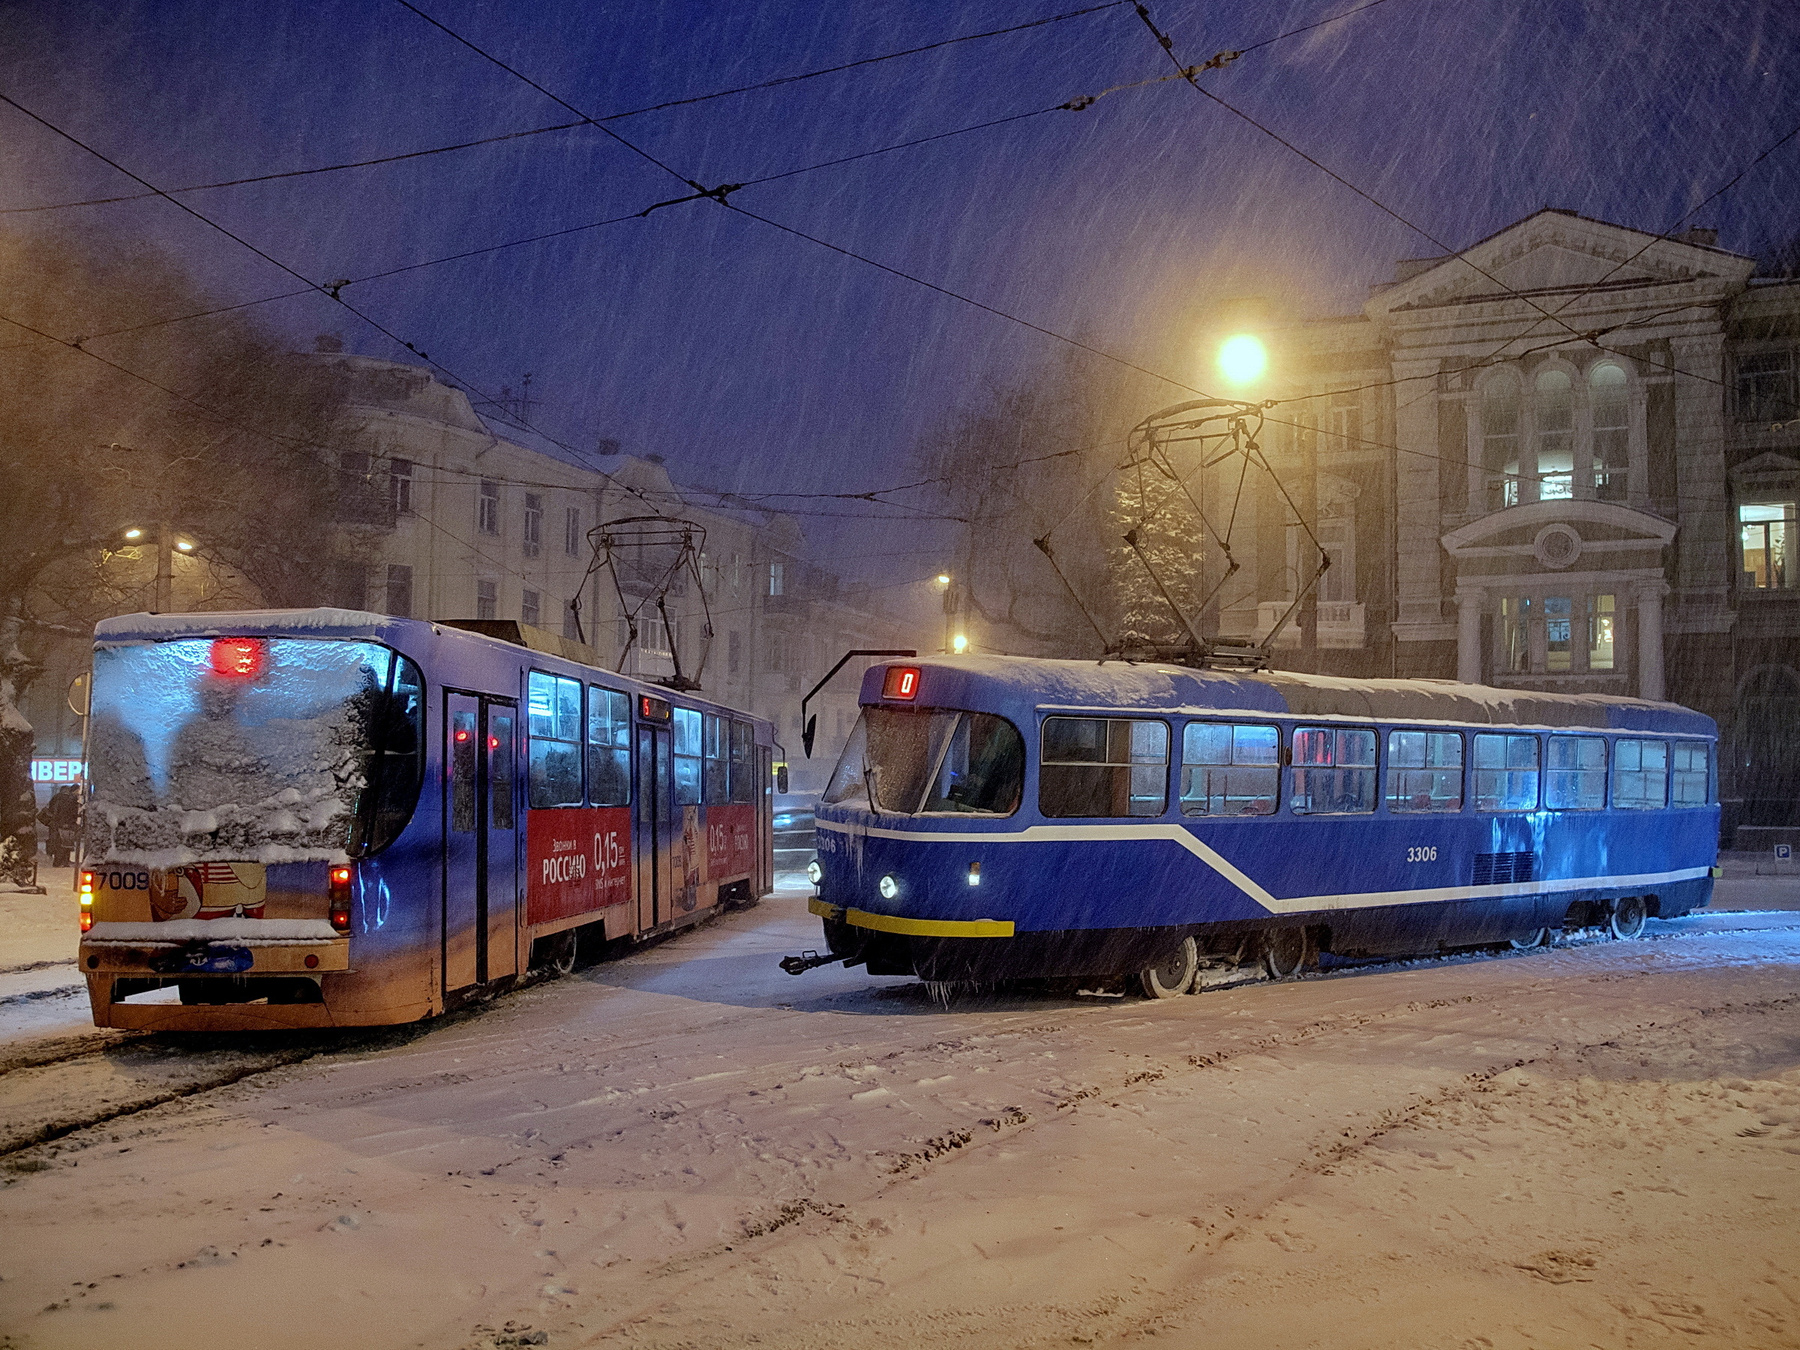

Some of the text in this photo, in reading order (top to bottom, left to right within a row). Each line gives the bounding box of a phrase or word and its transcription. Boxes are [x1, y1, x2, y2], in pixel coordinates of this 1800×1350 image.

[901, 673, 914, 693] 0
[594, 831, 618, 877] 0,15
[1407, 846, 1437, 862] 3306
[96, 872, 150, 890] 7009
